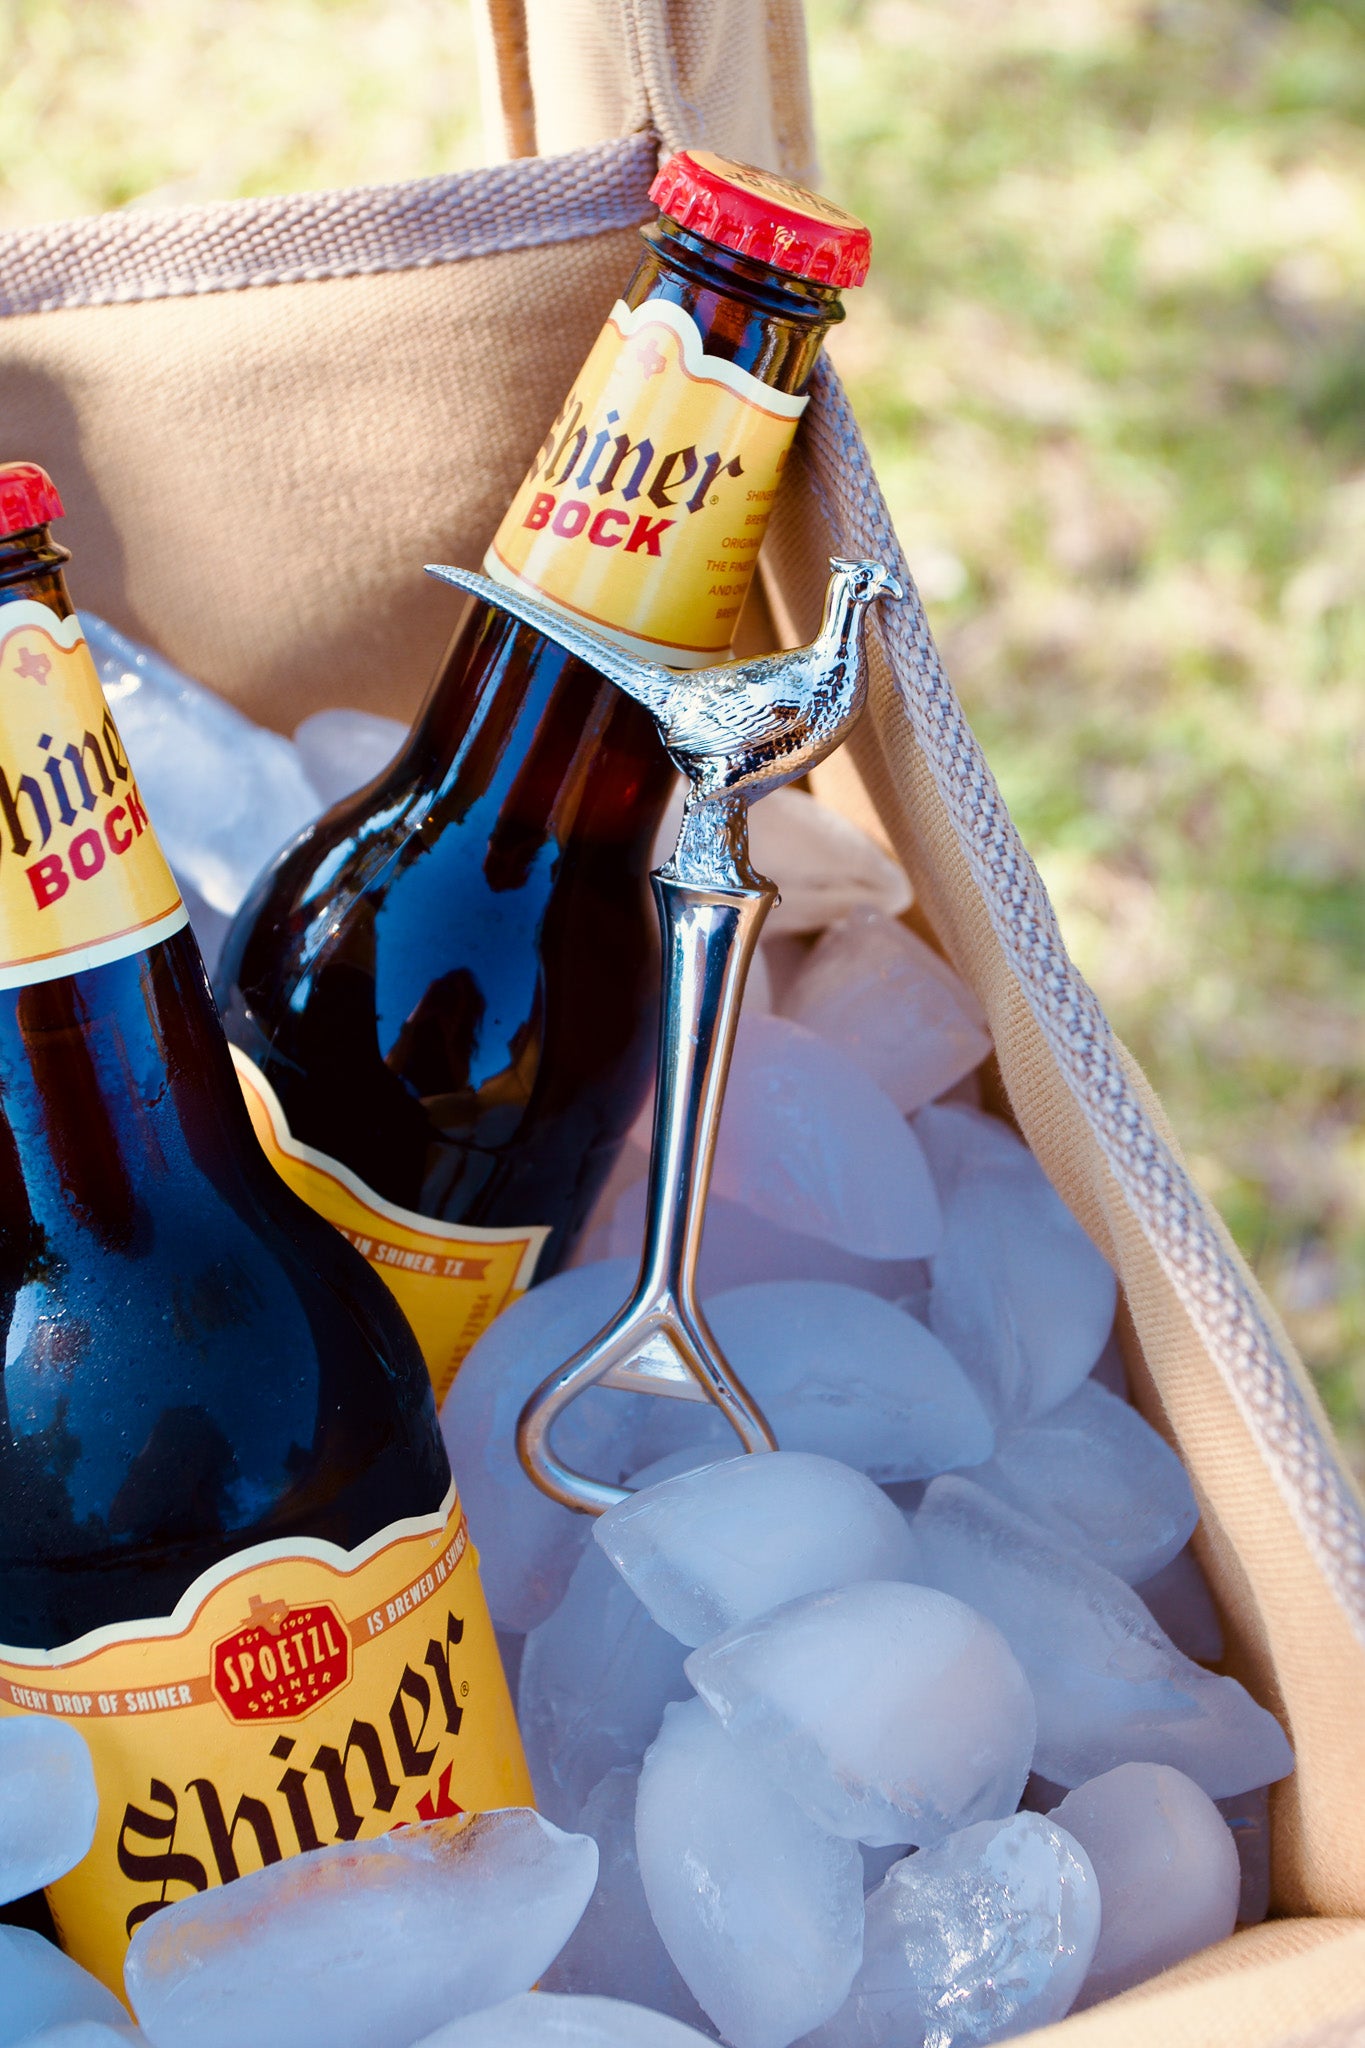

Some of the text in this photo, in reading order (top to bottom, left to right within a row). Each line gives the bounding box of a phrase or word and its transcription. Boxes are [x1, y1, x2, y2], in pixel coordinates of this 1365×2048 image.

[522, 492, 677, 557] BOCK
[706, 560, 727, 572] THE
[708, 585, 731, 596] AND
[0, 707, 128, 858] hine
[25, 782, 149, 911] BOCK
[354, 1236, 466, 1277] IN SHINER, TX
[366, 1610, 385, 1636] IS
[385, 1572, 435, 1624] BREWED
[434, 1559, 447, 1584] IN
[238, 1612, 312, 1646] EST 1909
[223, 1621, 340, 1694] SPOETZL
[10, 1684, 192, 1715] EVERY DROP OF SHINER
[247, 1671, 332, 1713] SHINER
[279, 1691, 307, 1710] TX
[117, 1610, 464, 1941] Shiner
